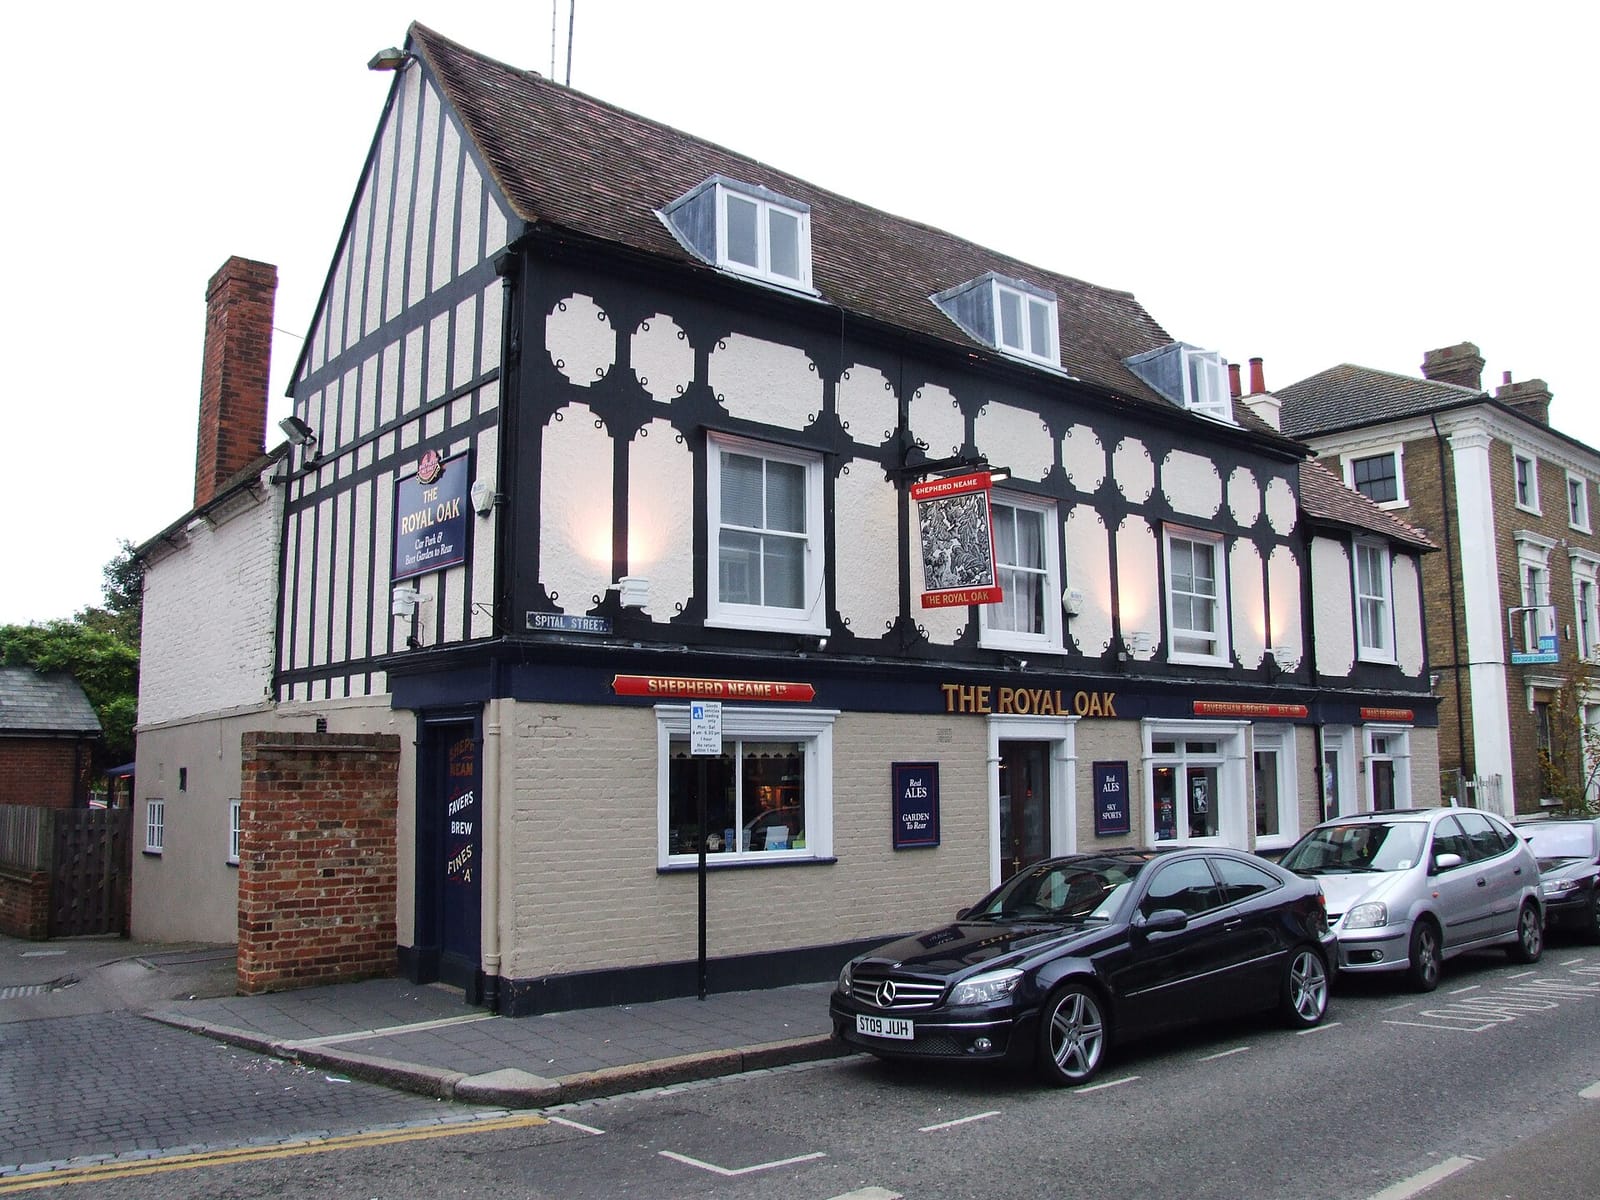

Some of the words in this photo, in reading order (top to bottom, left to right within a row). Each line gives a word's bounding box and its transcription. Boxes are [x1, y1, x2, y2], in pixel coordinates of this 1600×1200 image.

[915, 483, 952, 495] SHEPHERD
[953, 478, 978, 489] NEAME
[423, 486, 438, 504] THE
[401, 508, 434, 535] ROYAL
[436, 497, 460, 523] OAK
[415, 539, 425, 550] Car
[437, 531, 443, 543] &
[417, 548, 433, 561] Garden
[435, 548, 440, 556] to
[441, 544, 453, 555] Rear
[926, 594, 941, 605] THE
[942, 592, 969, 604] ROYAL
[970, 591, 989, 601] OAK
[535, 615, 566, 628] SPITAL
[648, 679, 723, 695] SHEPHERD
[727, 682, 772, 697] NEAME
[941, 683, 992, 714] THE
[998, 686, 1069, 716] ROYAL
[1074, 690, 1117, 717] OAK
[904, 787, 928, 799] ALES
[1102, 783, 1120, 793] ALES
[448, 790, 474, 816] FAVERS
[1106, 803, 1117, 811] SKY
[902, 813, 930, 822] GARDEN
[1102, 811, 1122, 820] SPORTS
[451, 821, 473, 835] BREW
[906, 822, 914, 830] To
[913, 822, 927, 830] Rear
[859, 1016, 883, 1034] ST09
[885, 1021, 909, 1036] JUH
